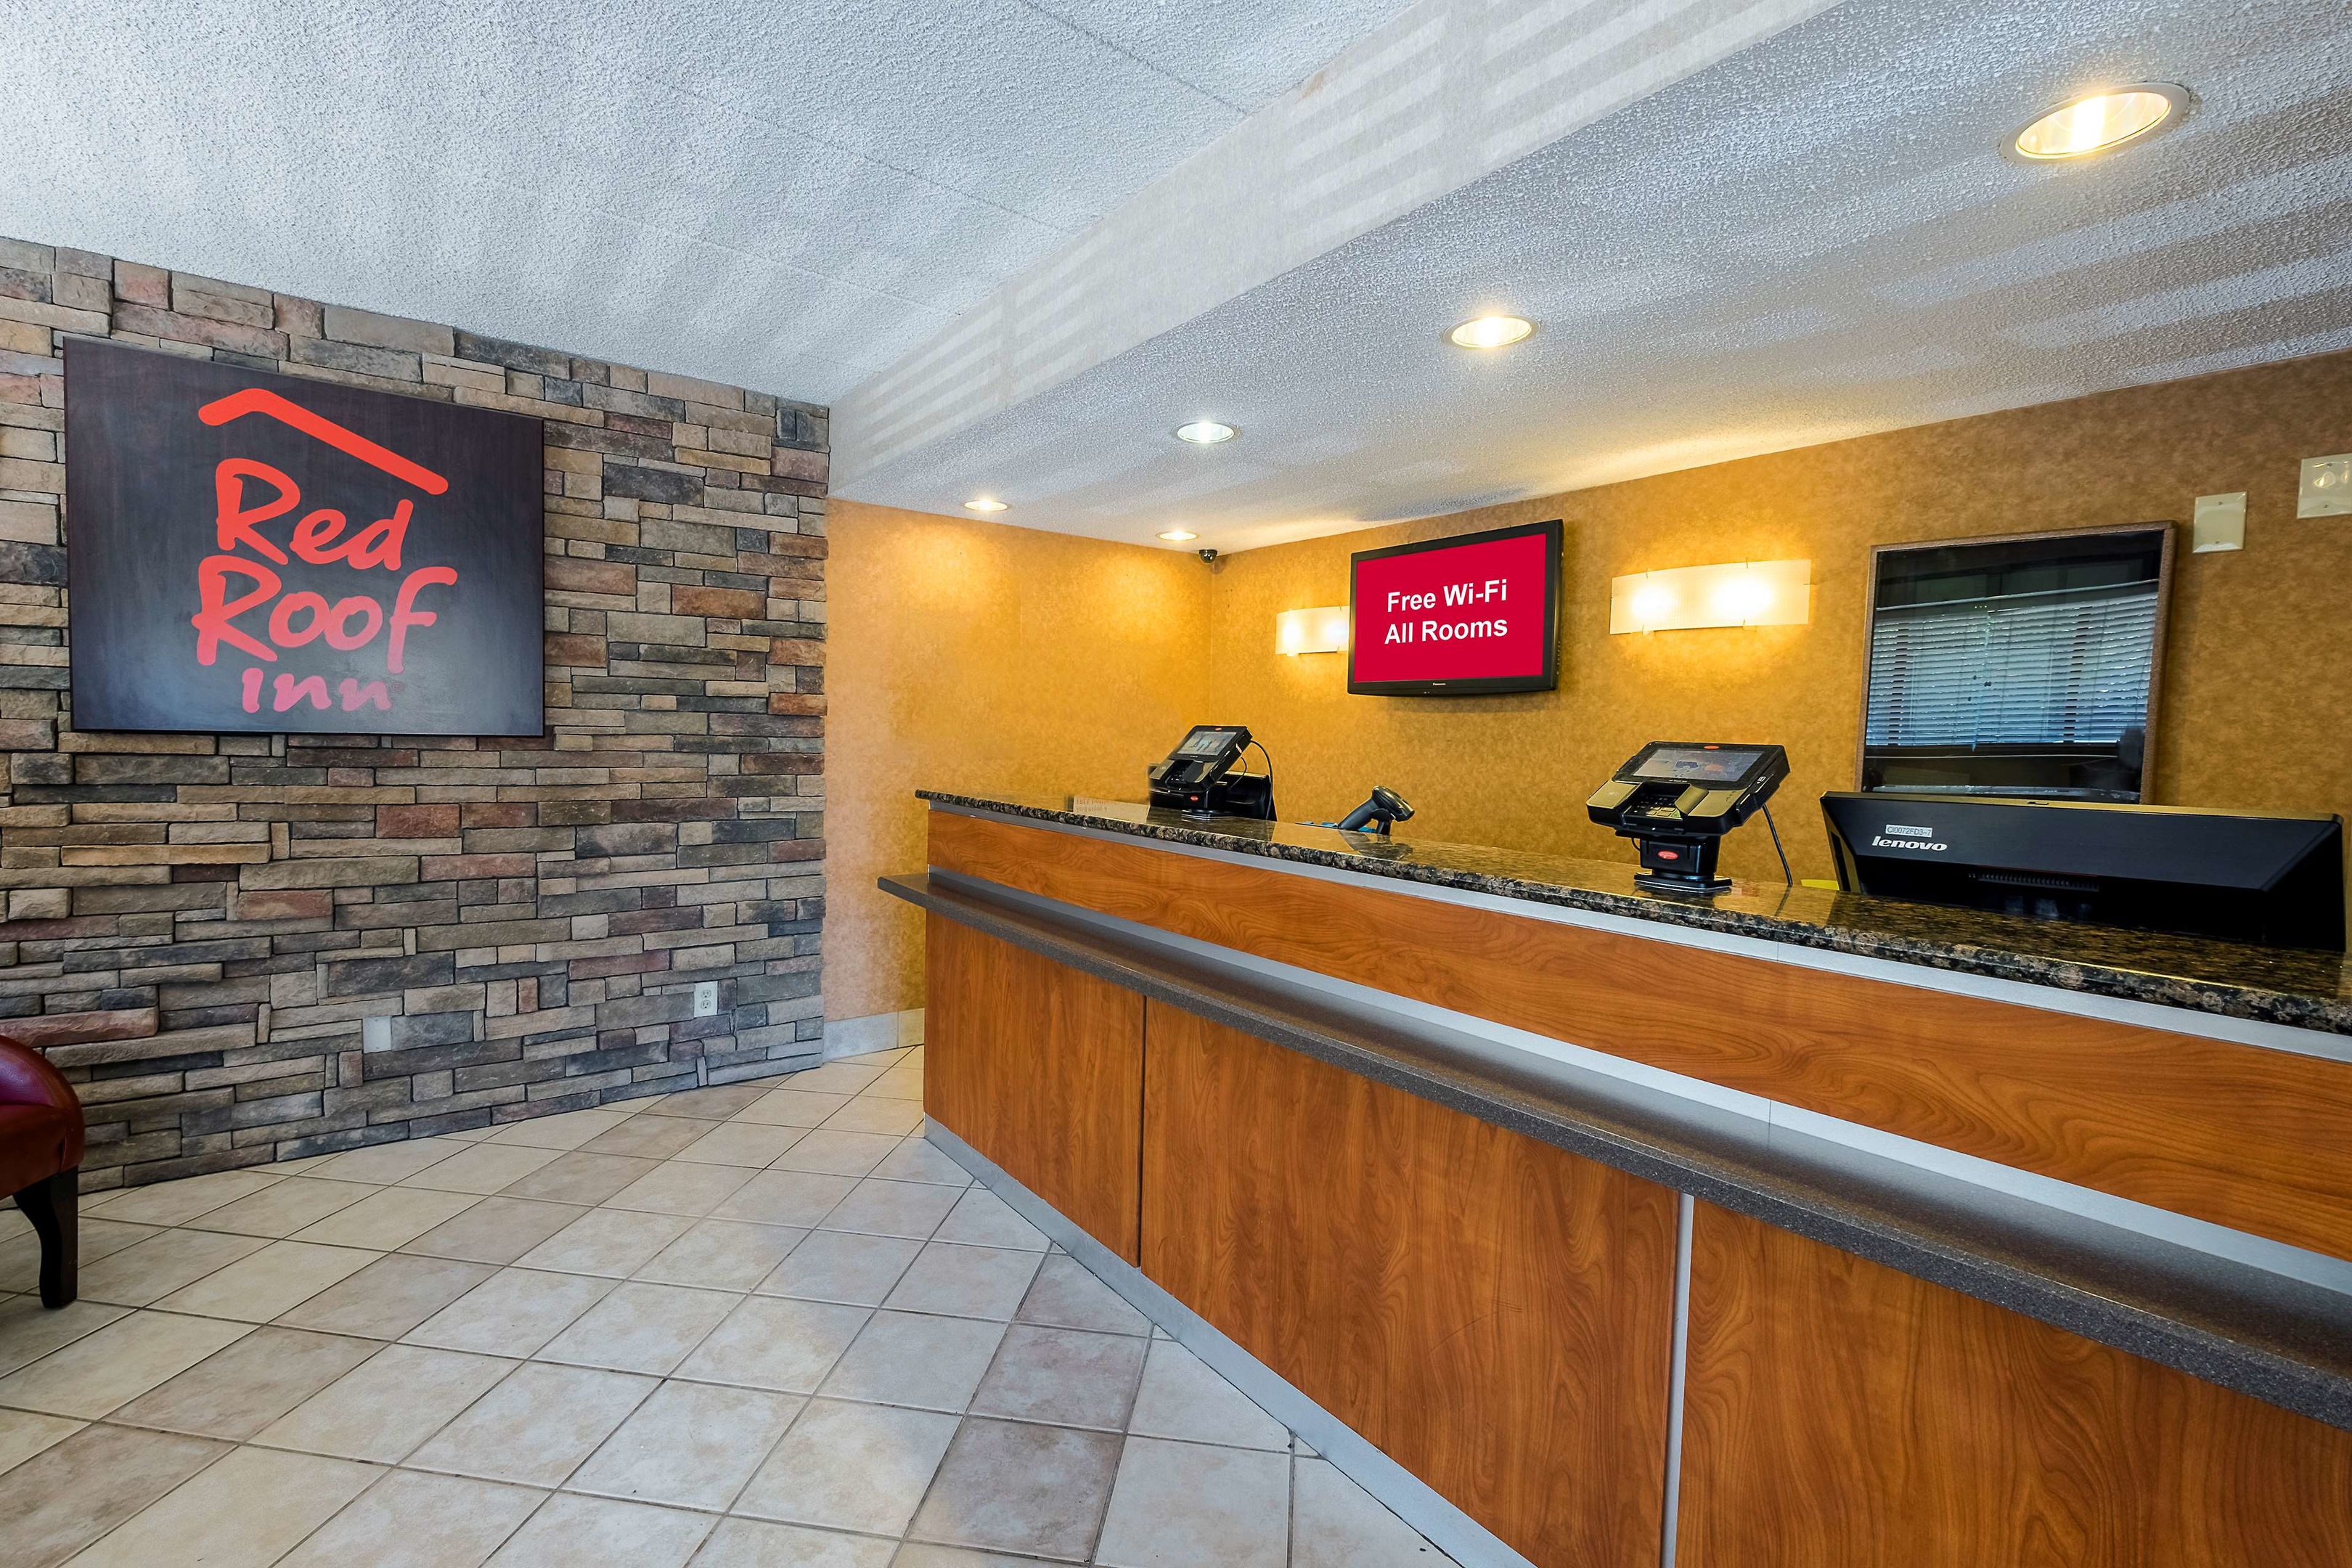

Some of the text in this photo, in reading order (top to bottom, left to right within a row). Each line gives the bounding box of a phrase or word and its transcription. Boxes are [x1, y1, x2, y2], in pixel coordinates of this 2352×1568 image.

[215, 457, 415, 571] Red
[191, 555, 459, 674] Roof
[1387, 579, 1507, 613] Free Wi-Fi
[1384, 618, 1508, 645] All Rooms
[242, 667, 391, 714] Inn
[1871, 836, 1948, 852] lenovo
